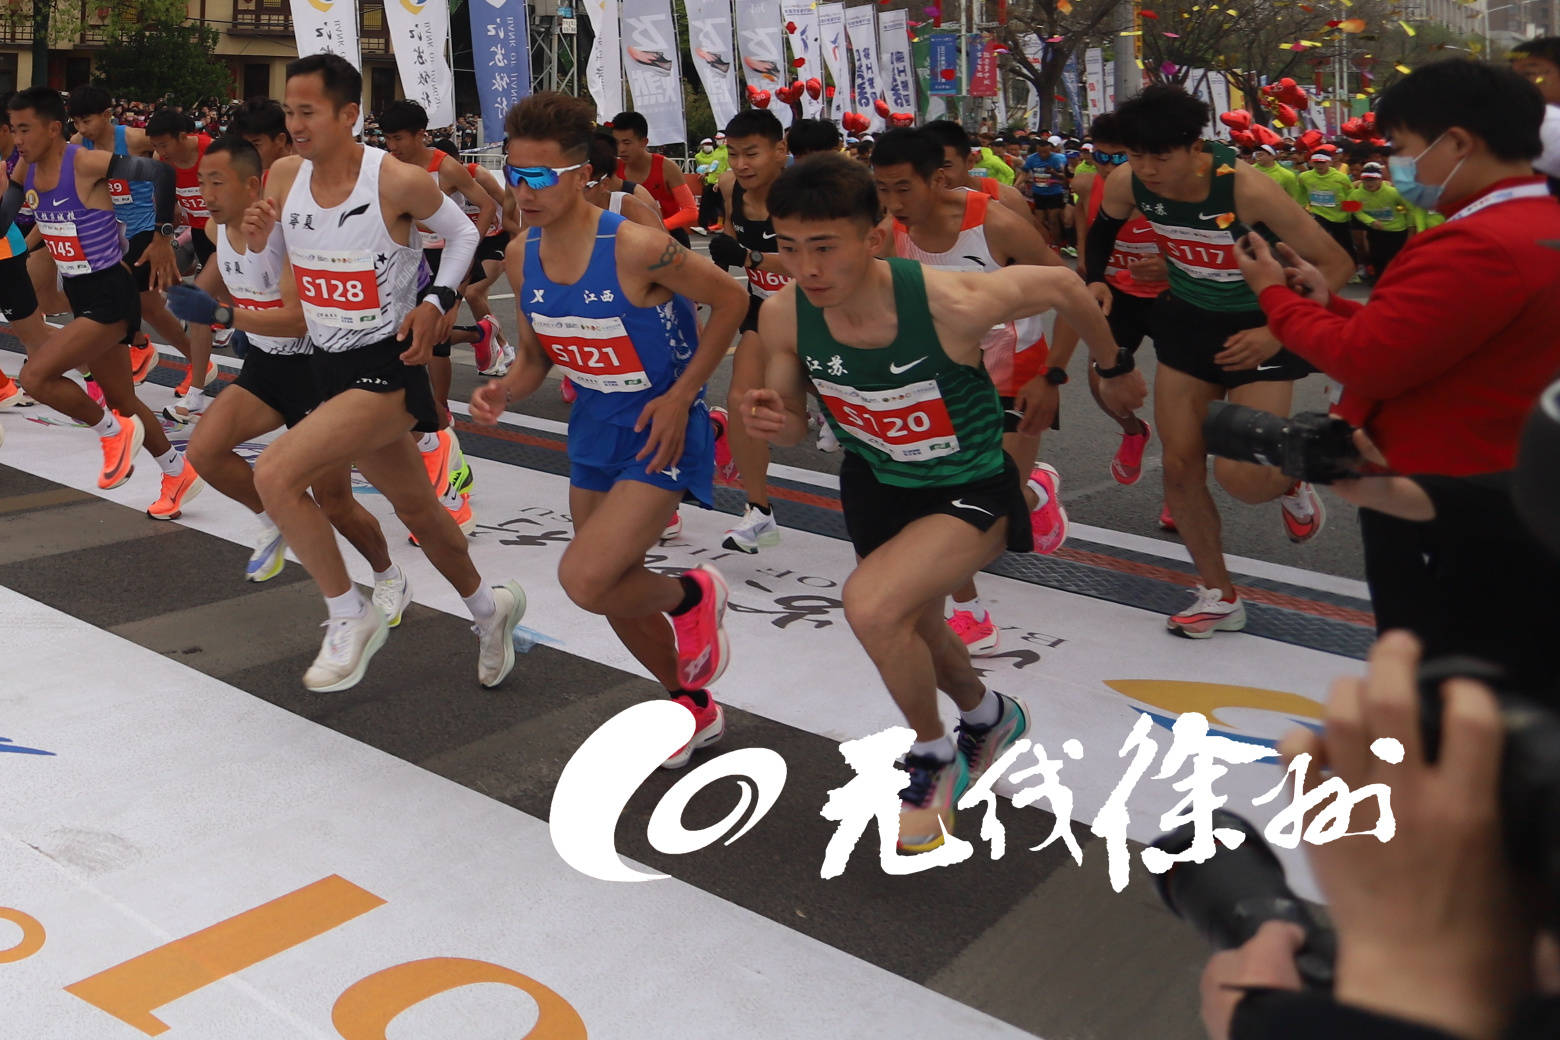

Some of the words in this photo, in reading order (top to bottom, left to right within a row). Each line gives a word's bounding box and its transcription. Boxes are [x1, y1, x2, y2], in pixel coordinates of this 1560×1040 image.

[1141, 202, 1168, 216] 江苏
[1167, 241, 1225, 265] S117
[302, 275, 365, 303] S128
[583, 289, 615, 304] 江西
[551, 343, 621, 369] S121
[806, 354, 849, 377] 江苏
[843, 406, 931, 438] S120
